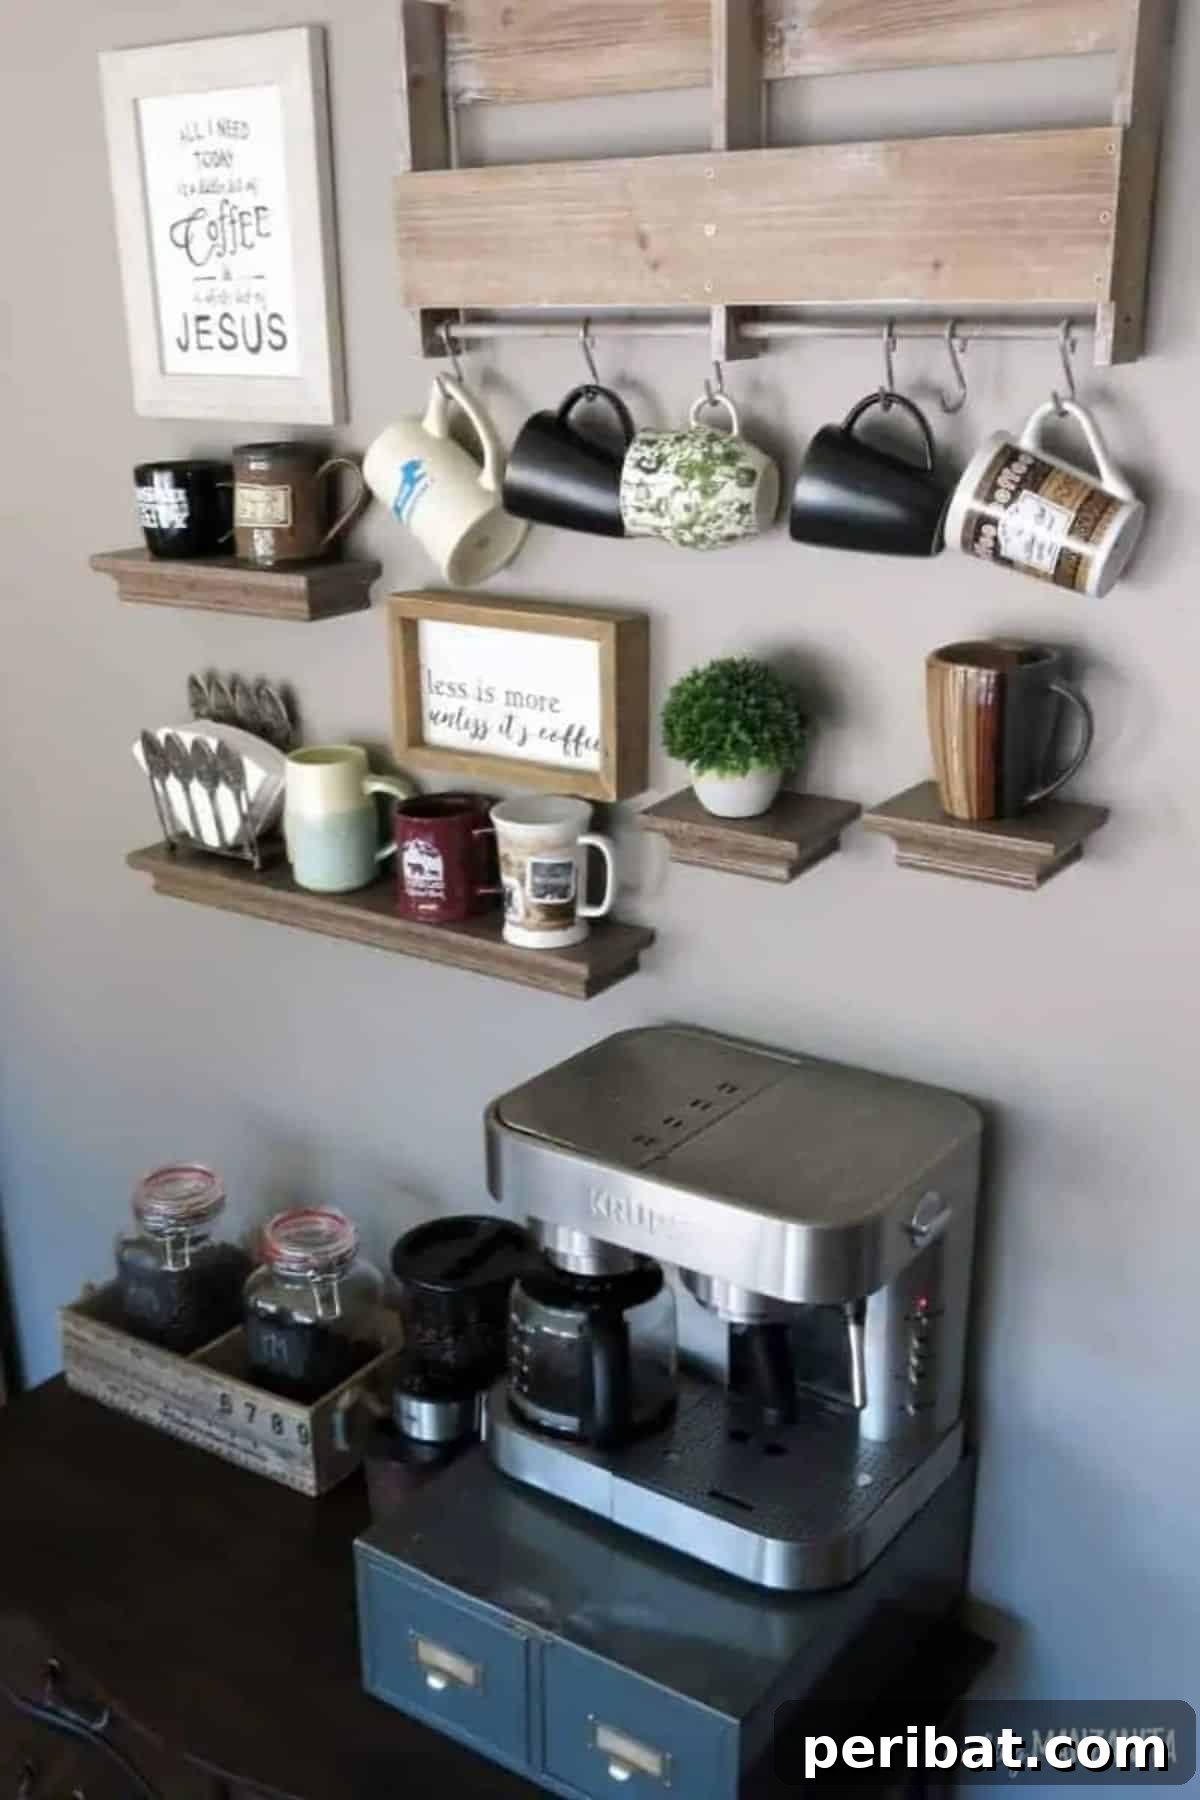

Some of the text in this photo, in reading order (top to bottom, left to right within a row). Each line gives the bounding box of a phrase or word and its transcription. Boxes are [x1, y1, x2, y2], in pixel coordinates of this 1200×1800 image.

[216, 118, 250, 140] NEED
[176, 311, 287, 354] JESUS
[427, 668, 562, 714] less is more
[428, 706, 489, 741] unless
[590, 1188, 669, 1235] KRUP
[244, 1401, 256, 1424] 7
